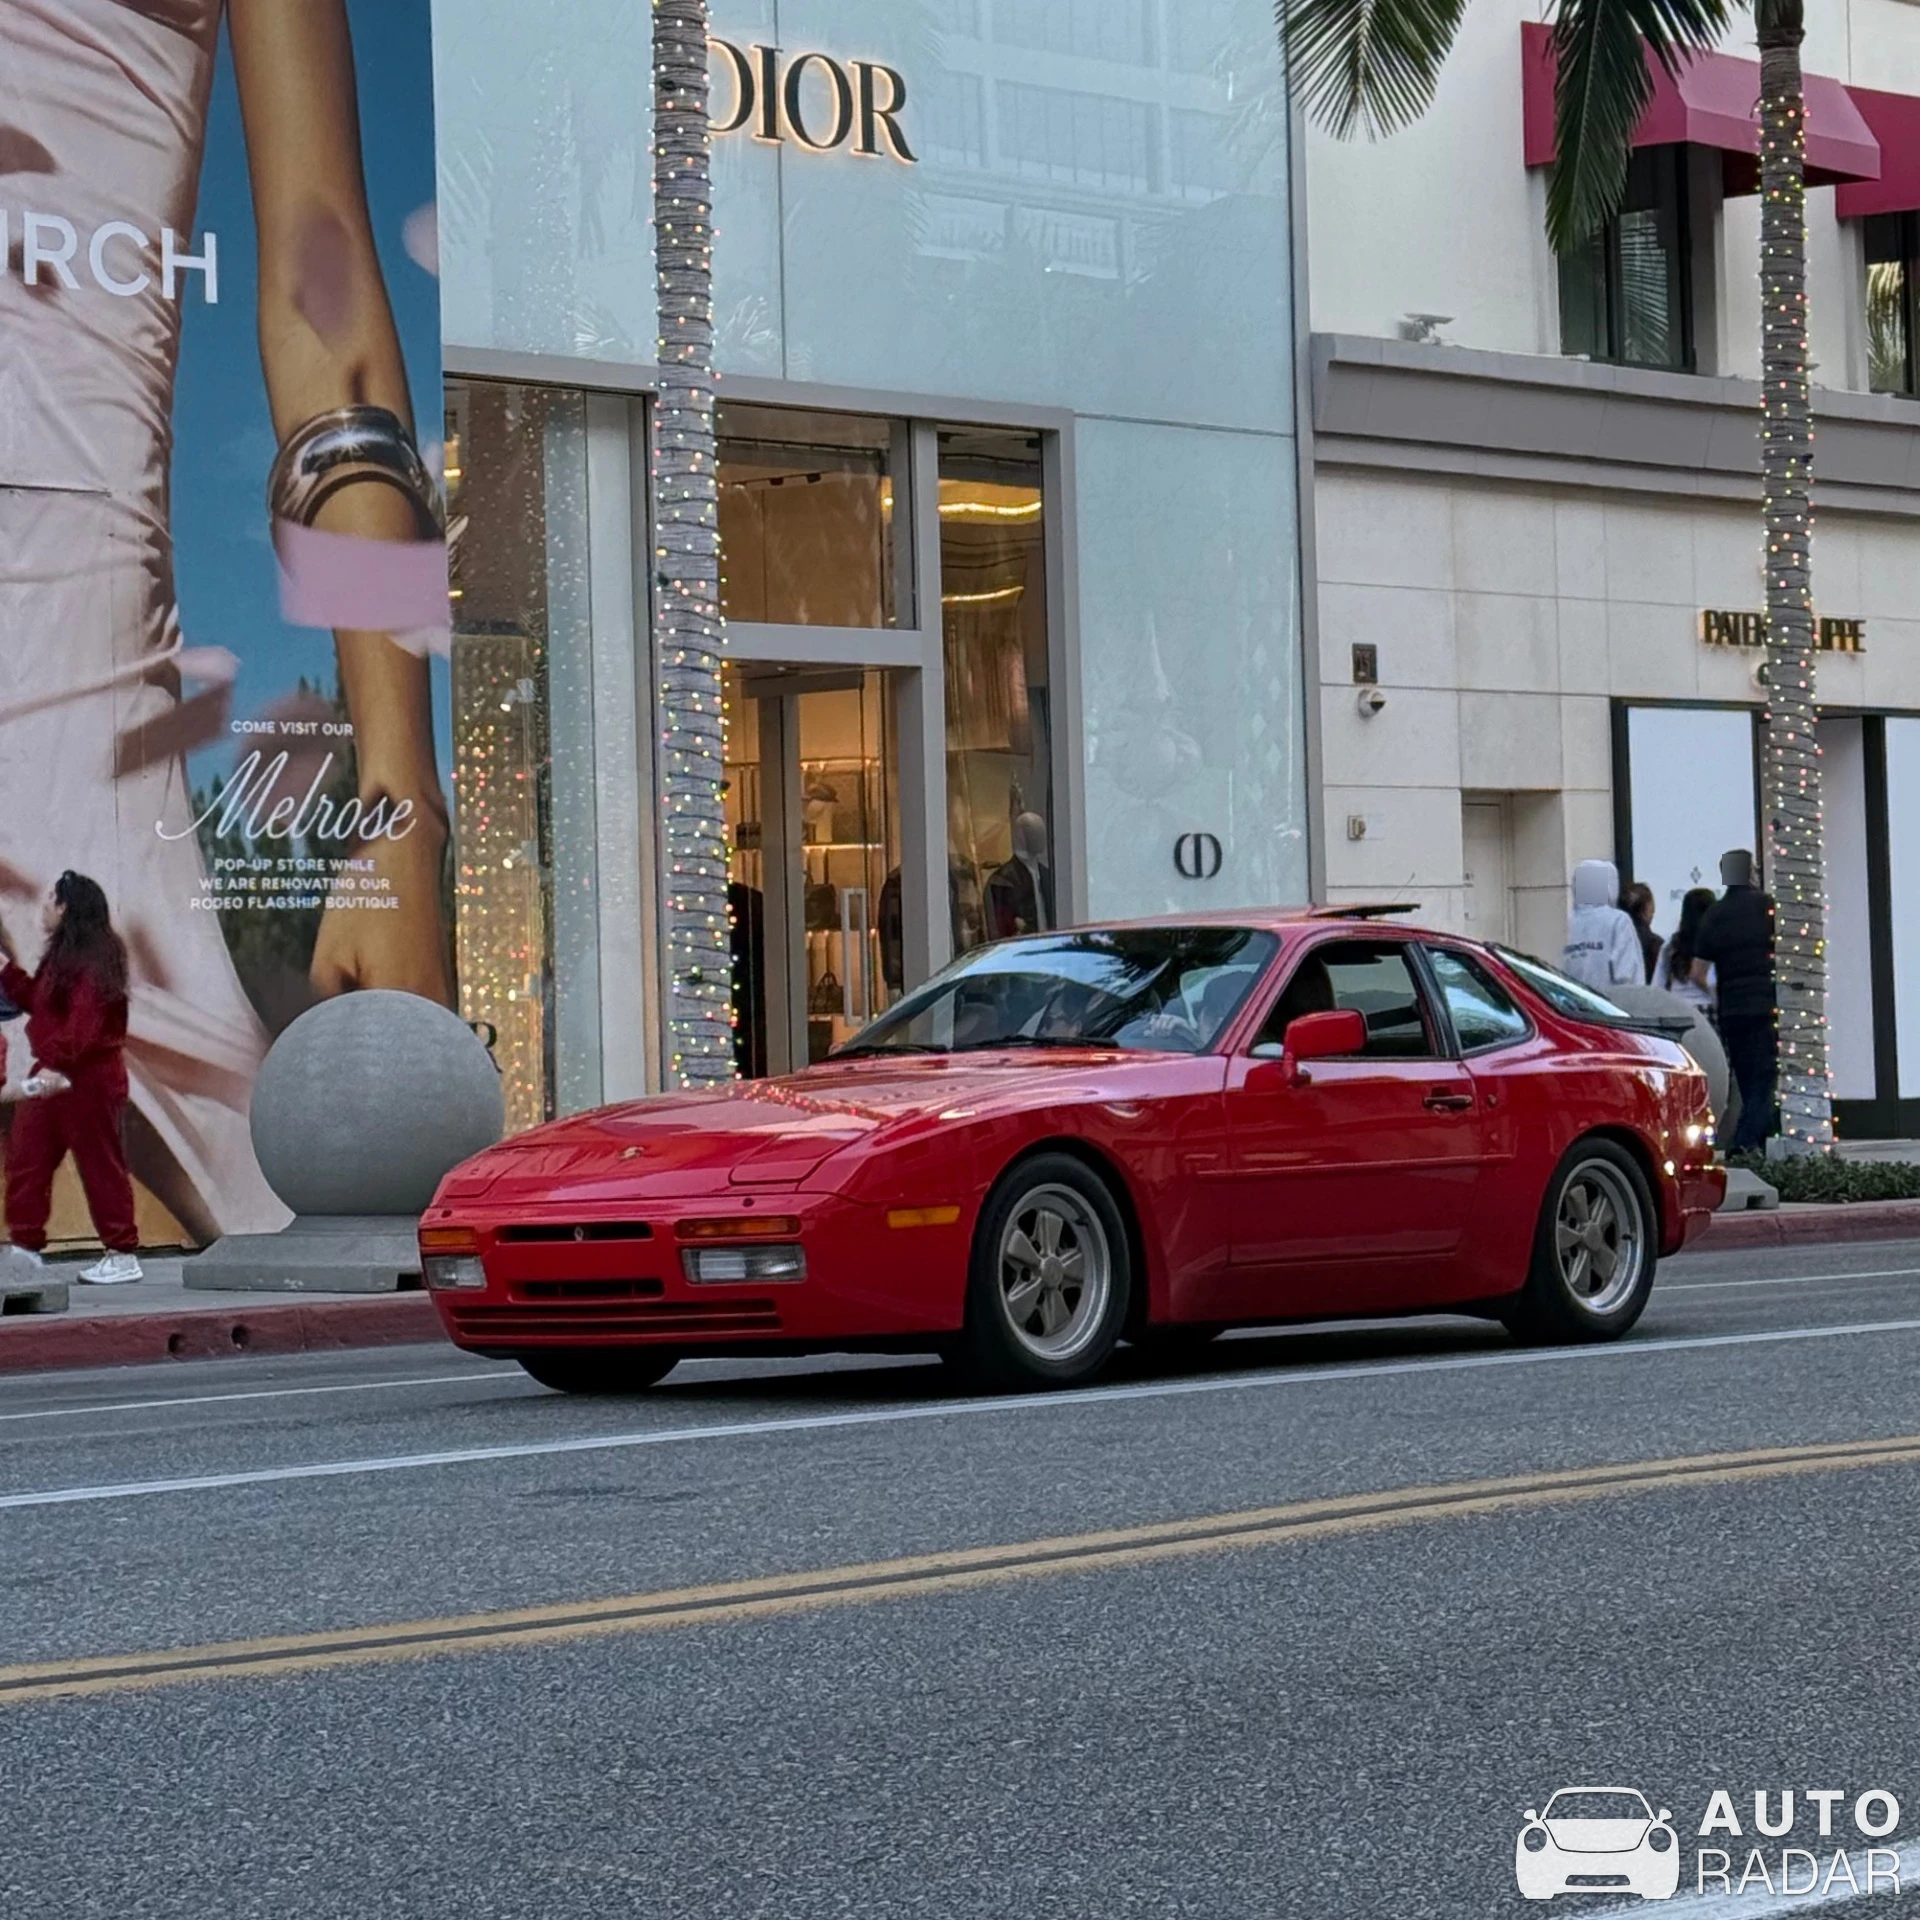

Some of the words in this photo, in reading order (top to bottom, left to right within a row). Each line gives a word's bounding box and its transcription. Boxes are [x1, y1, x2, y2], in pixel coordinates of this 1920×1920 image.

[706, 37, 919, 162] DIOR
[0, 209, 218, 304] RCH
[231, 720, 276, 735] COME
[280, 721, 318, 736] VISIT
[321, 722, 354, 737] OUR
[155, 750, 417, 841] Melrose
[213, 858, 272, 872] POP-UP
[276, 858, 326, 872] STORE
[329, 858, 376, 872] WHILE
[199, 877, 223, 891] WE
[226, 877, 257, 891] ARE
[260, 877, 356, 891] RENOVATING
[359, 877, 391, 891] OUR
[189, 896, 244, 910] RODEO
[247, 896, 321, 910] FLAGSHIP
[324, 896, 399, 910] BOUTIQUE
